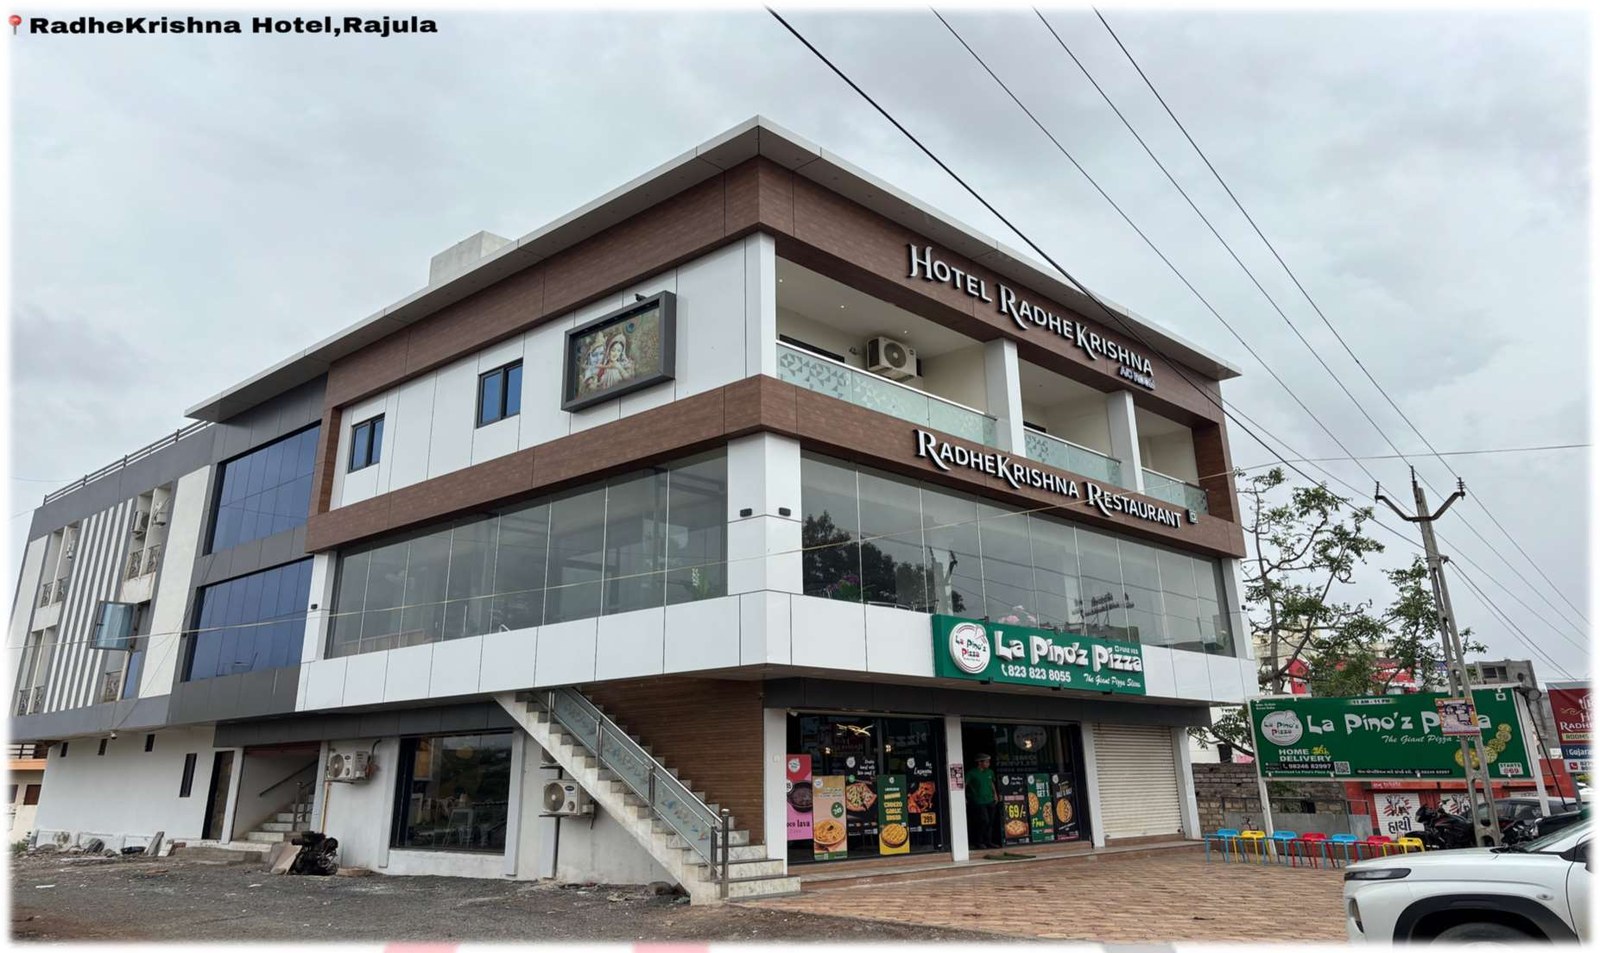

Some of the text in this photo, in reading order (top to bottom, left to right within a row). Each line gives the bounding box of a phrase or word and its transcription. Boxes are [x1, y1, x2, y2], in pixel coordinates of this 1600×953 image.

[908, 244, 993, 303] HOTEL
[1086, 481, 1183, 528] RESTAURANT
[994, 630, 1143, 672] La Pino'z Pizza
[1008, 666, 1072, 683] 823 823 8055
[1307, 715, 1335, 735] La
[1344, 712, 1414, 735] Pino'z
[1382, 735, 1397, 743] The
[1400, 734, 1424, 743] Giant
[1427, 734, 1451, 744] Pizza
[797, 819, 810, 827] lava
[1388, 817, 1412, 835] હાથી
